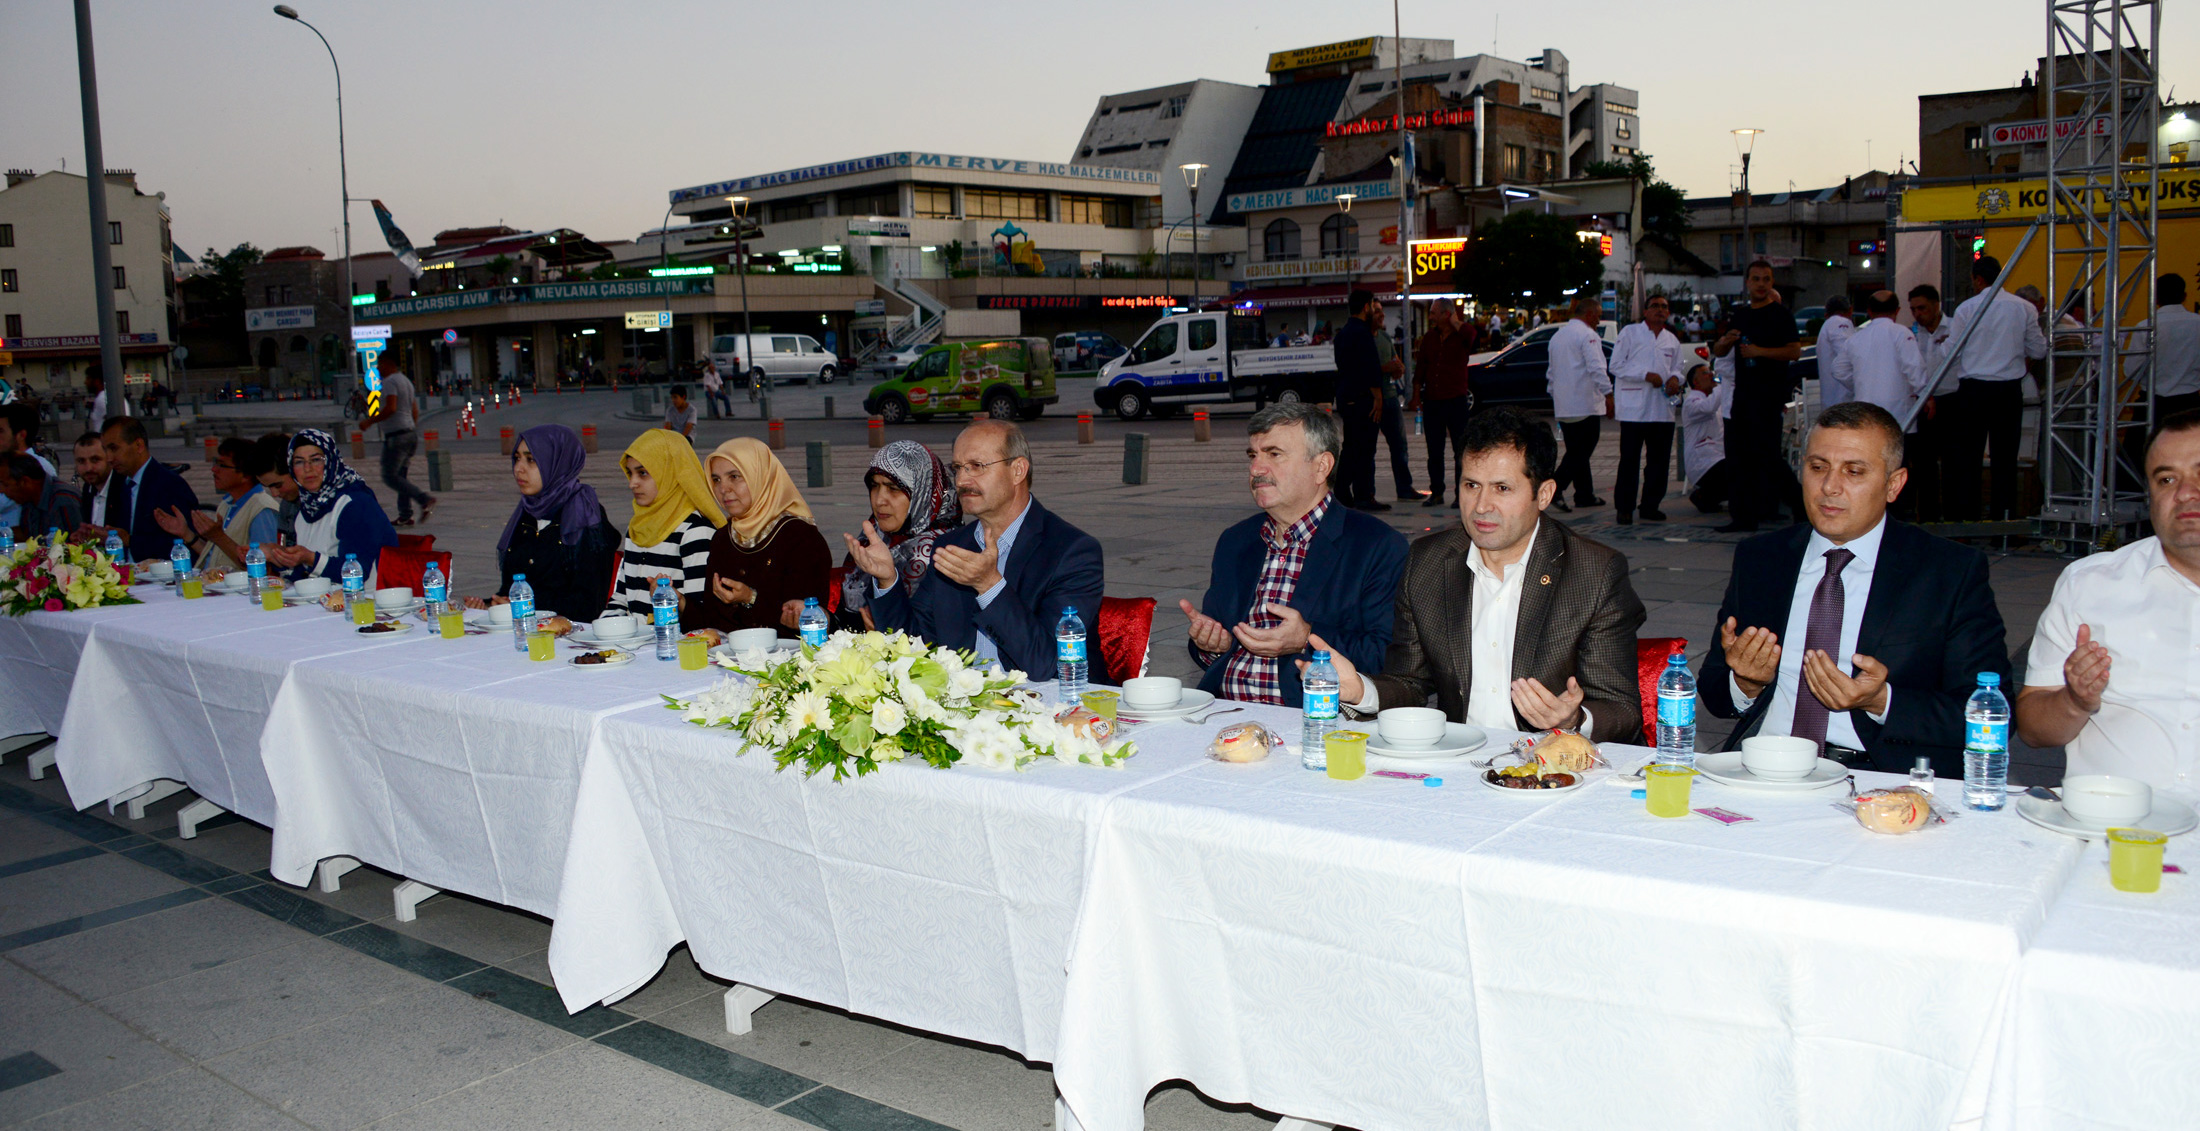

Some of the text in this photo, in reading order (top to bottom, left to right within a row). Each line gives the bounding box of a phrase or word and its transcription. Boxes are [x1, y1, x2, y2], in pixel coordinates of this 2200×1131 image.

[2011, 119, 2104, 142] KONYA NAGE
[761, 172, 787, 187] HAC
[791, 155, 891, 181] MALZEMELERİ
[915, 153, 1158, 183] MERVE HAC MALZEMELERİ
[1245, 190, 1293, 209] MERVE
[1306, 187, 1329, 205] HAC
[2104, 178, 2200, 203] YÜKŞ
[1246, 262, 1282, 279] HEDİYELİK
[1309, 259, 1333, 274] KONYA
[535, 280, 684, 299] MEVLANA ÇARŞISI AVM
[363, 300, 414, 318] MEVLANA
[415, 296, 460, 312] ÇARŞISI
[462, 291, 488, 306] AVM
[61, 335, 96, 346] BAZAAR
[366, 350, 377, 369] P
